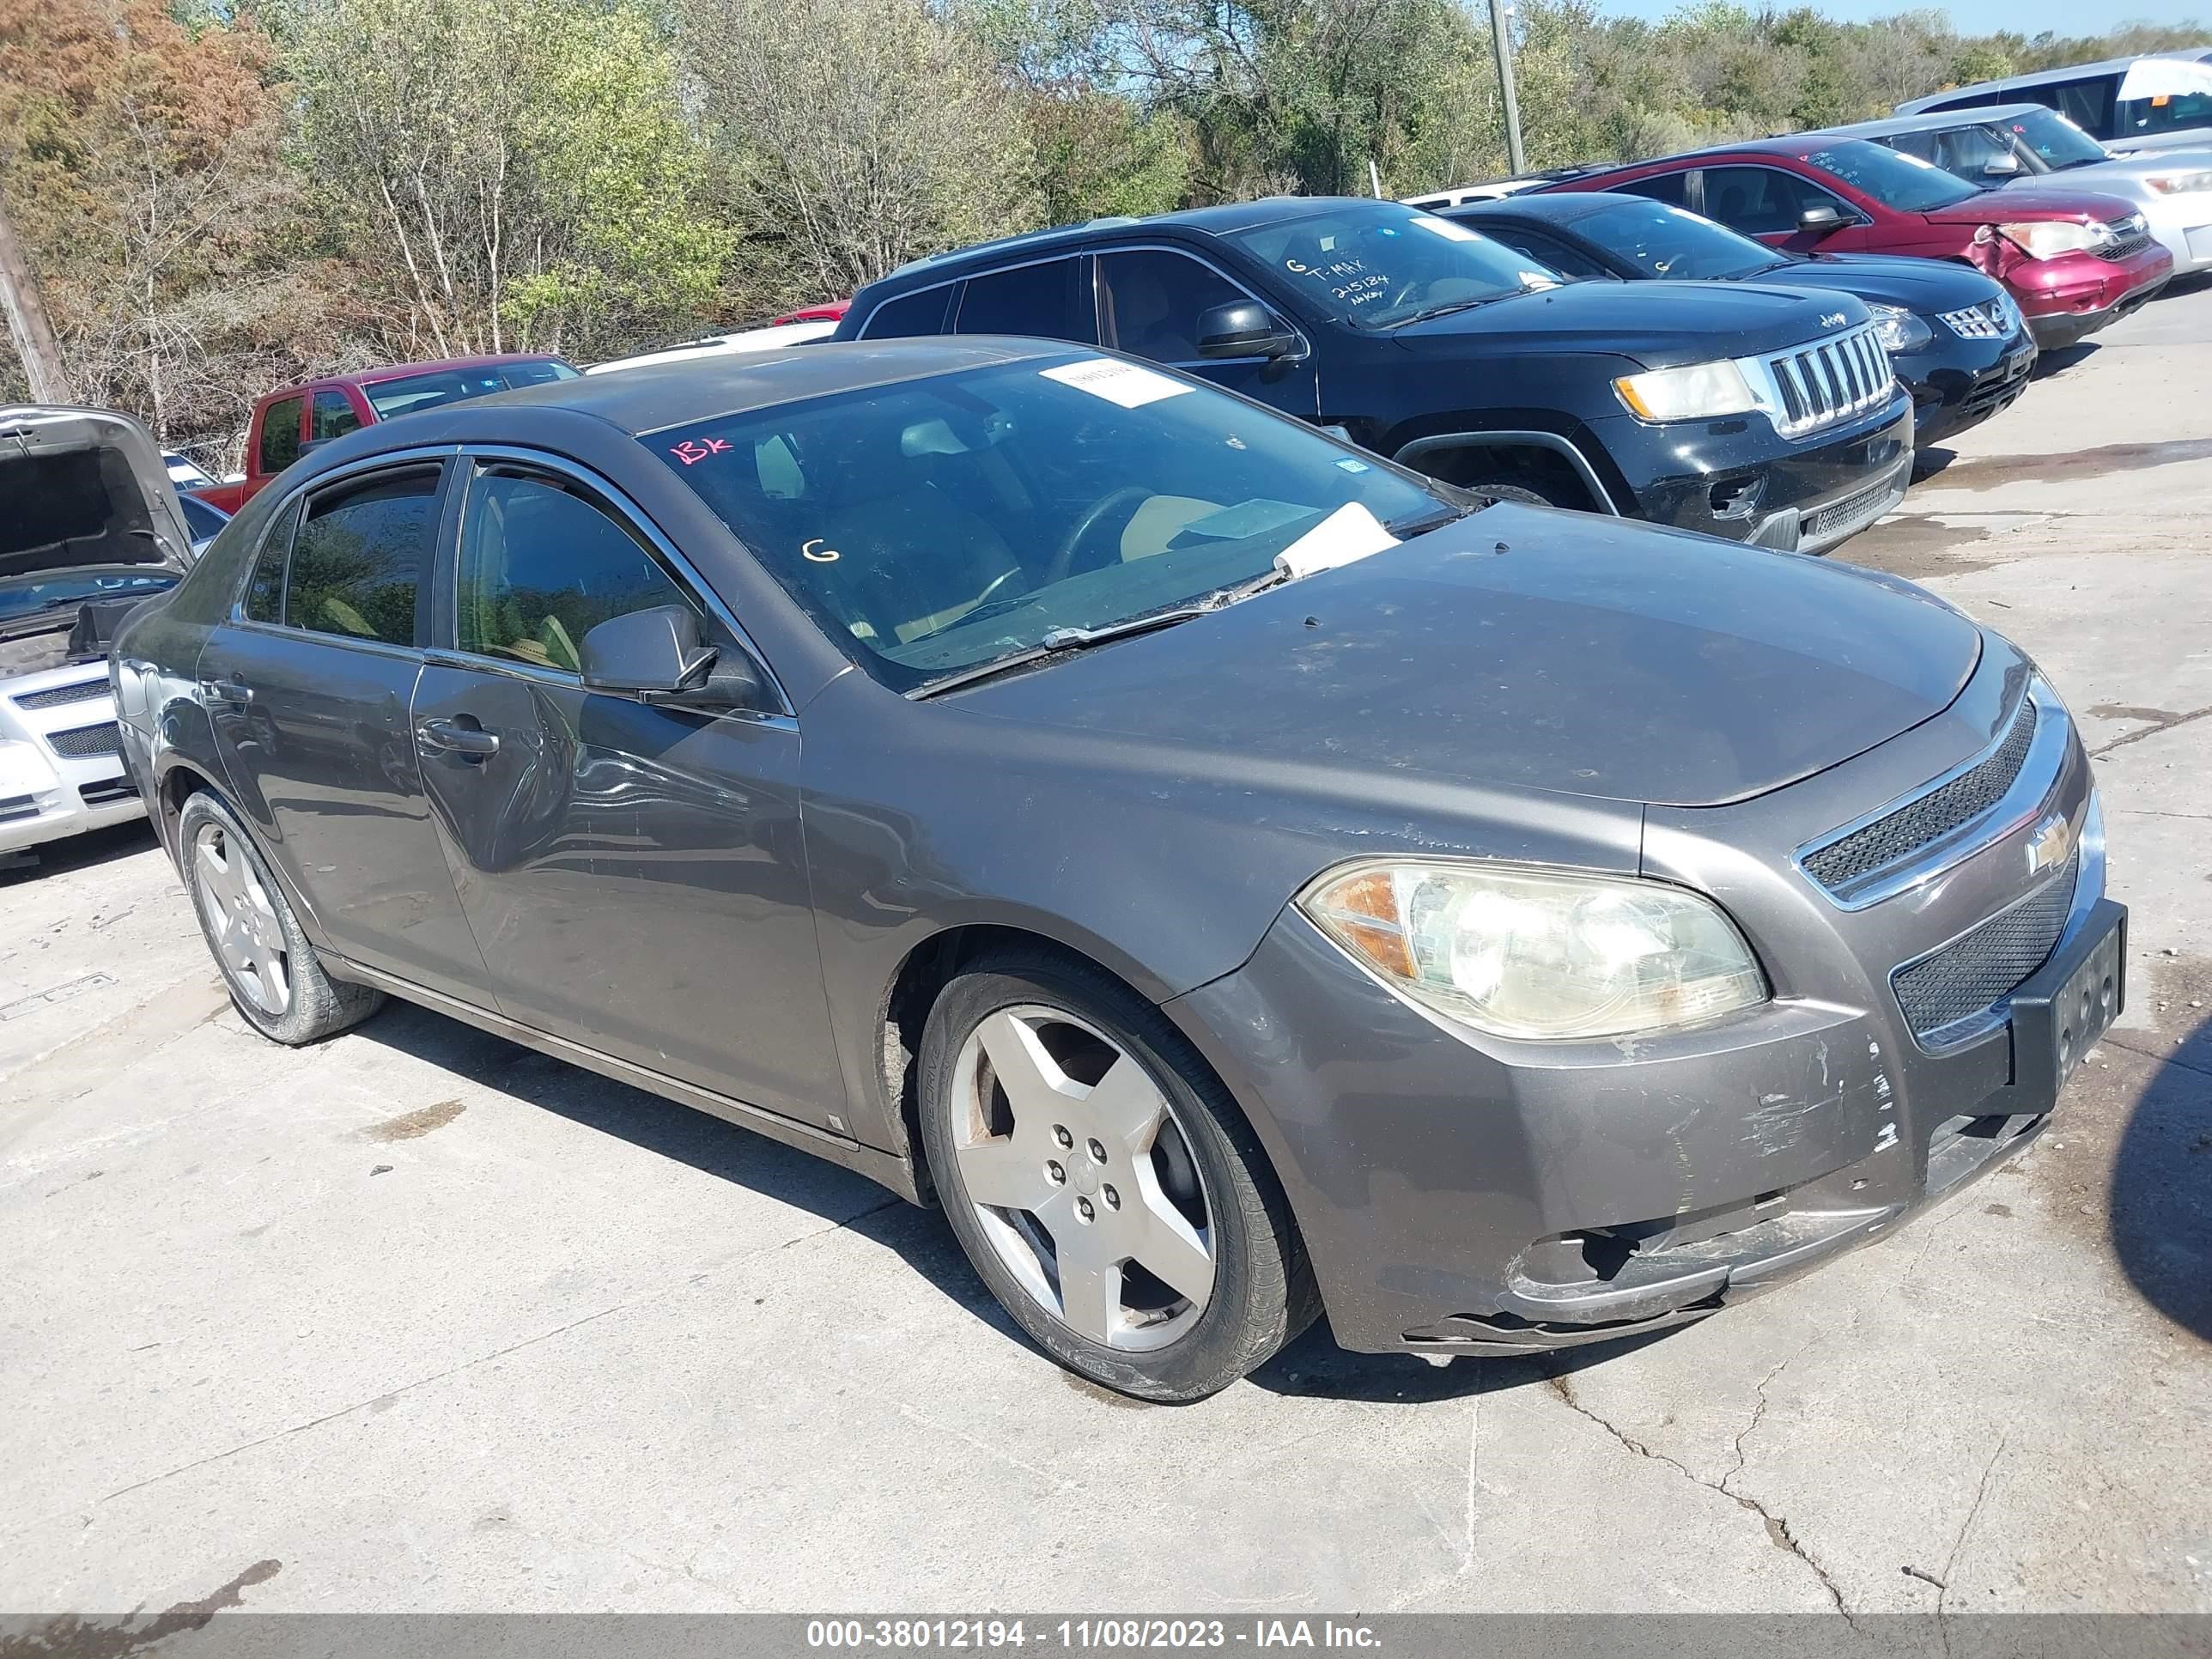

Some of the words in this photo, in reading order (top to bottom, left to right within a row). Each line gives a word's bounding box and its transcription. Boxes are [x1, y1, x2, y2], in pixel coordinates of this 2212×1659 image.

[1286, 259, 1306, 272] G
[1304, 259, 1367, 282] T-MAX
[1655, 261, 1669, 271] G
[1332, 275, 1389, 299] 215184
[801, 538, 841, 562] G
[925, 1046, 942, 1164] SUREDRIVE
